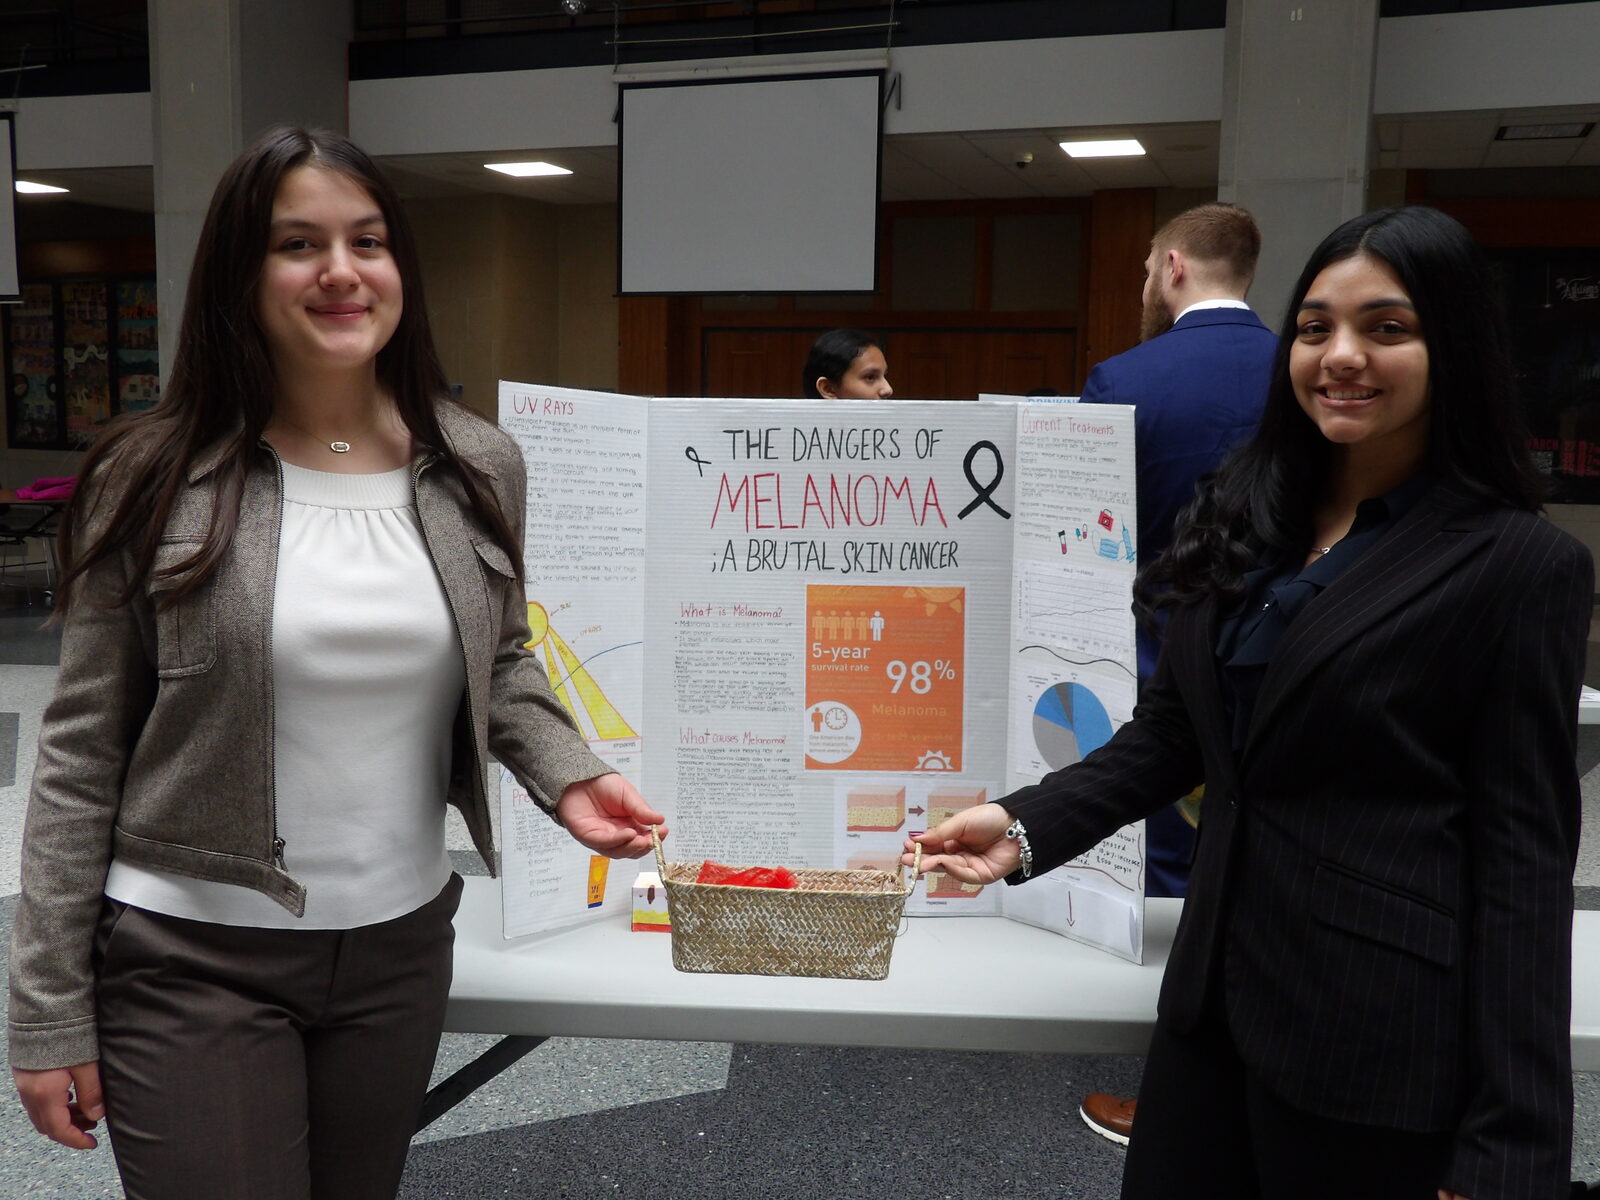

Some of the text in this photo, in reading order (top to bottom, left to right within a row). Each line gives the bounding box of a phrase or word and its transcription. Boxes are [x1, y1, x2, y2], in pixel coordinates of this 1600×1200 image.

[513, 393, 574, 415] UV RAYS
[1023, 408, 1115, 435] Current Treatments
[723, 427, 943, 461] THE DANGERS OF
[710, 472, 948, 533] MELANOMA
[747, 538, 835, 572] BRUTAL
[841, 540, 893, 573] SKIN
[900, 541, 959, 570] CANCER
[680, 601, 783, 618] What is Melanoma?
[812, 642, 872, 662] 5-year
[811, 663, 870, 672] survival rate
[886, 659, 956, 695] 98%
[871, 704, 947, 716] Melanoma
[679, 727, 710, 744] What
[712, 733, 739, 743] causes
